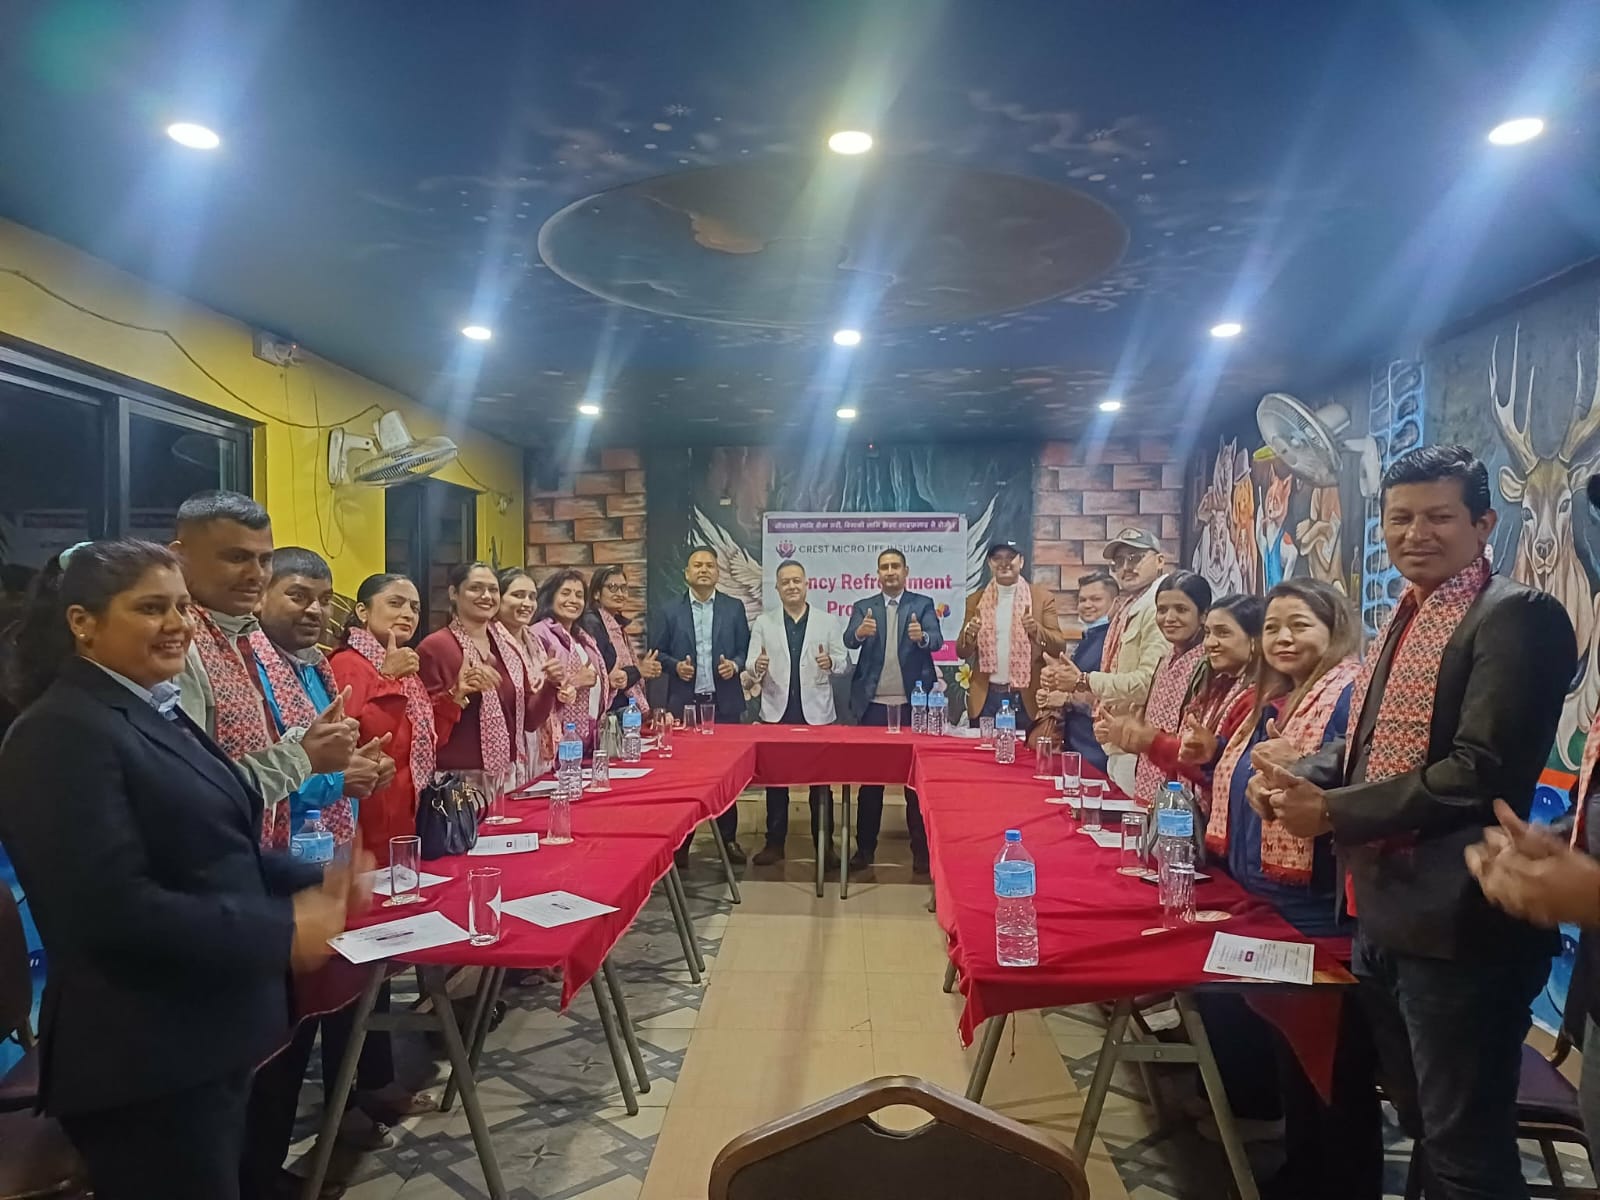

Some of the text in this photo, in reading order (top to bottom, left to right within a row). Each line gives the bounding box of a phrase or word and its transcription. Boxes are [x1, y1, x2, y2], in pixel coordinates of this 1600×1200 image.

[799, 544, 828, 553] CREST
[832, 544, 865, 553] MICRO
[808, 574, 952, 593] ncy Refrment
